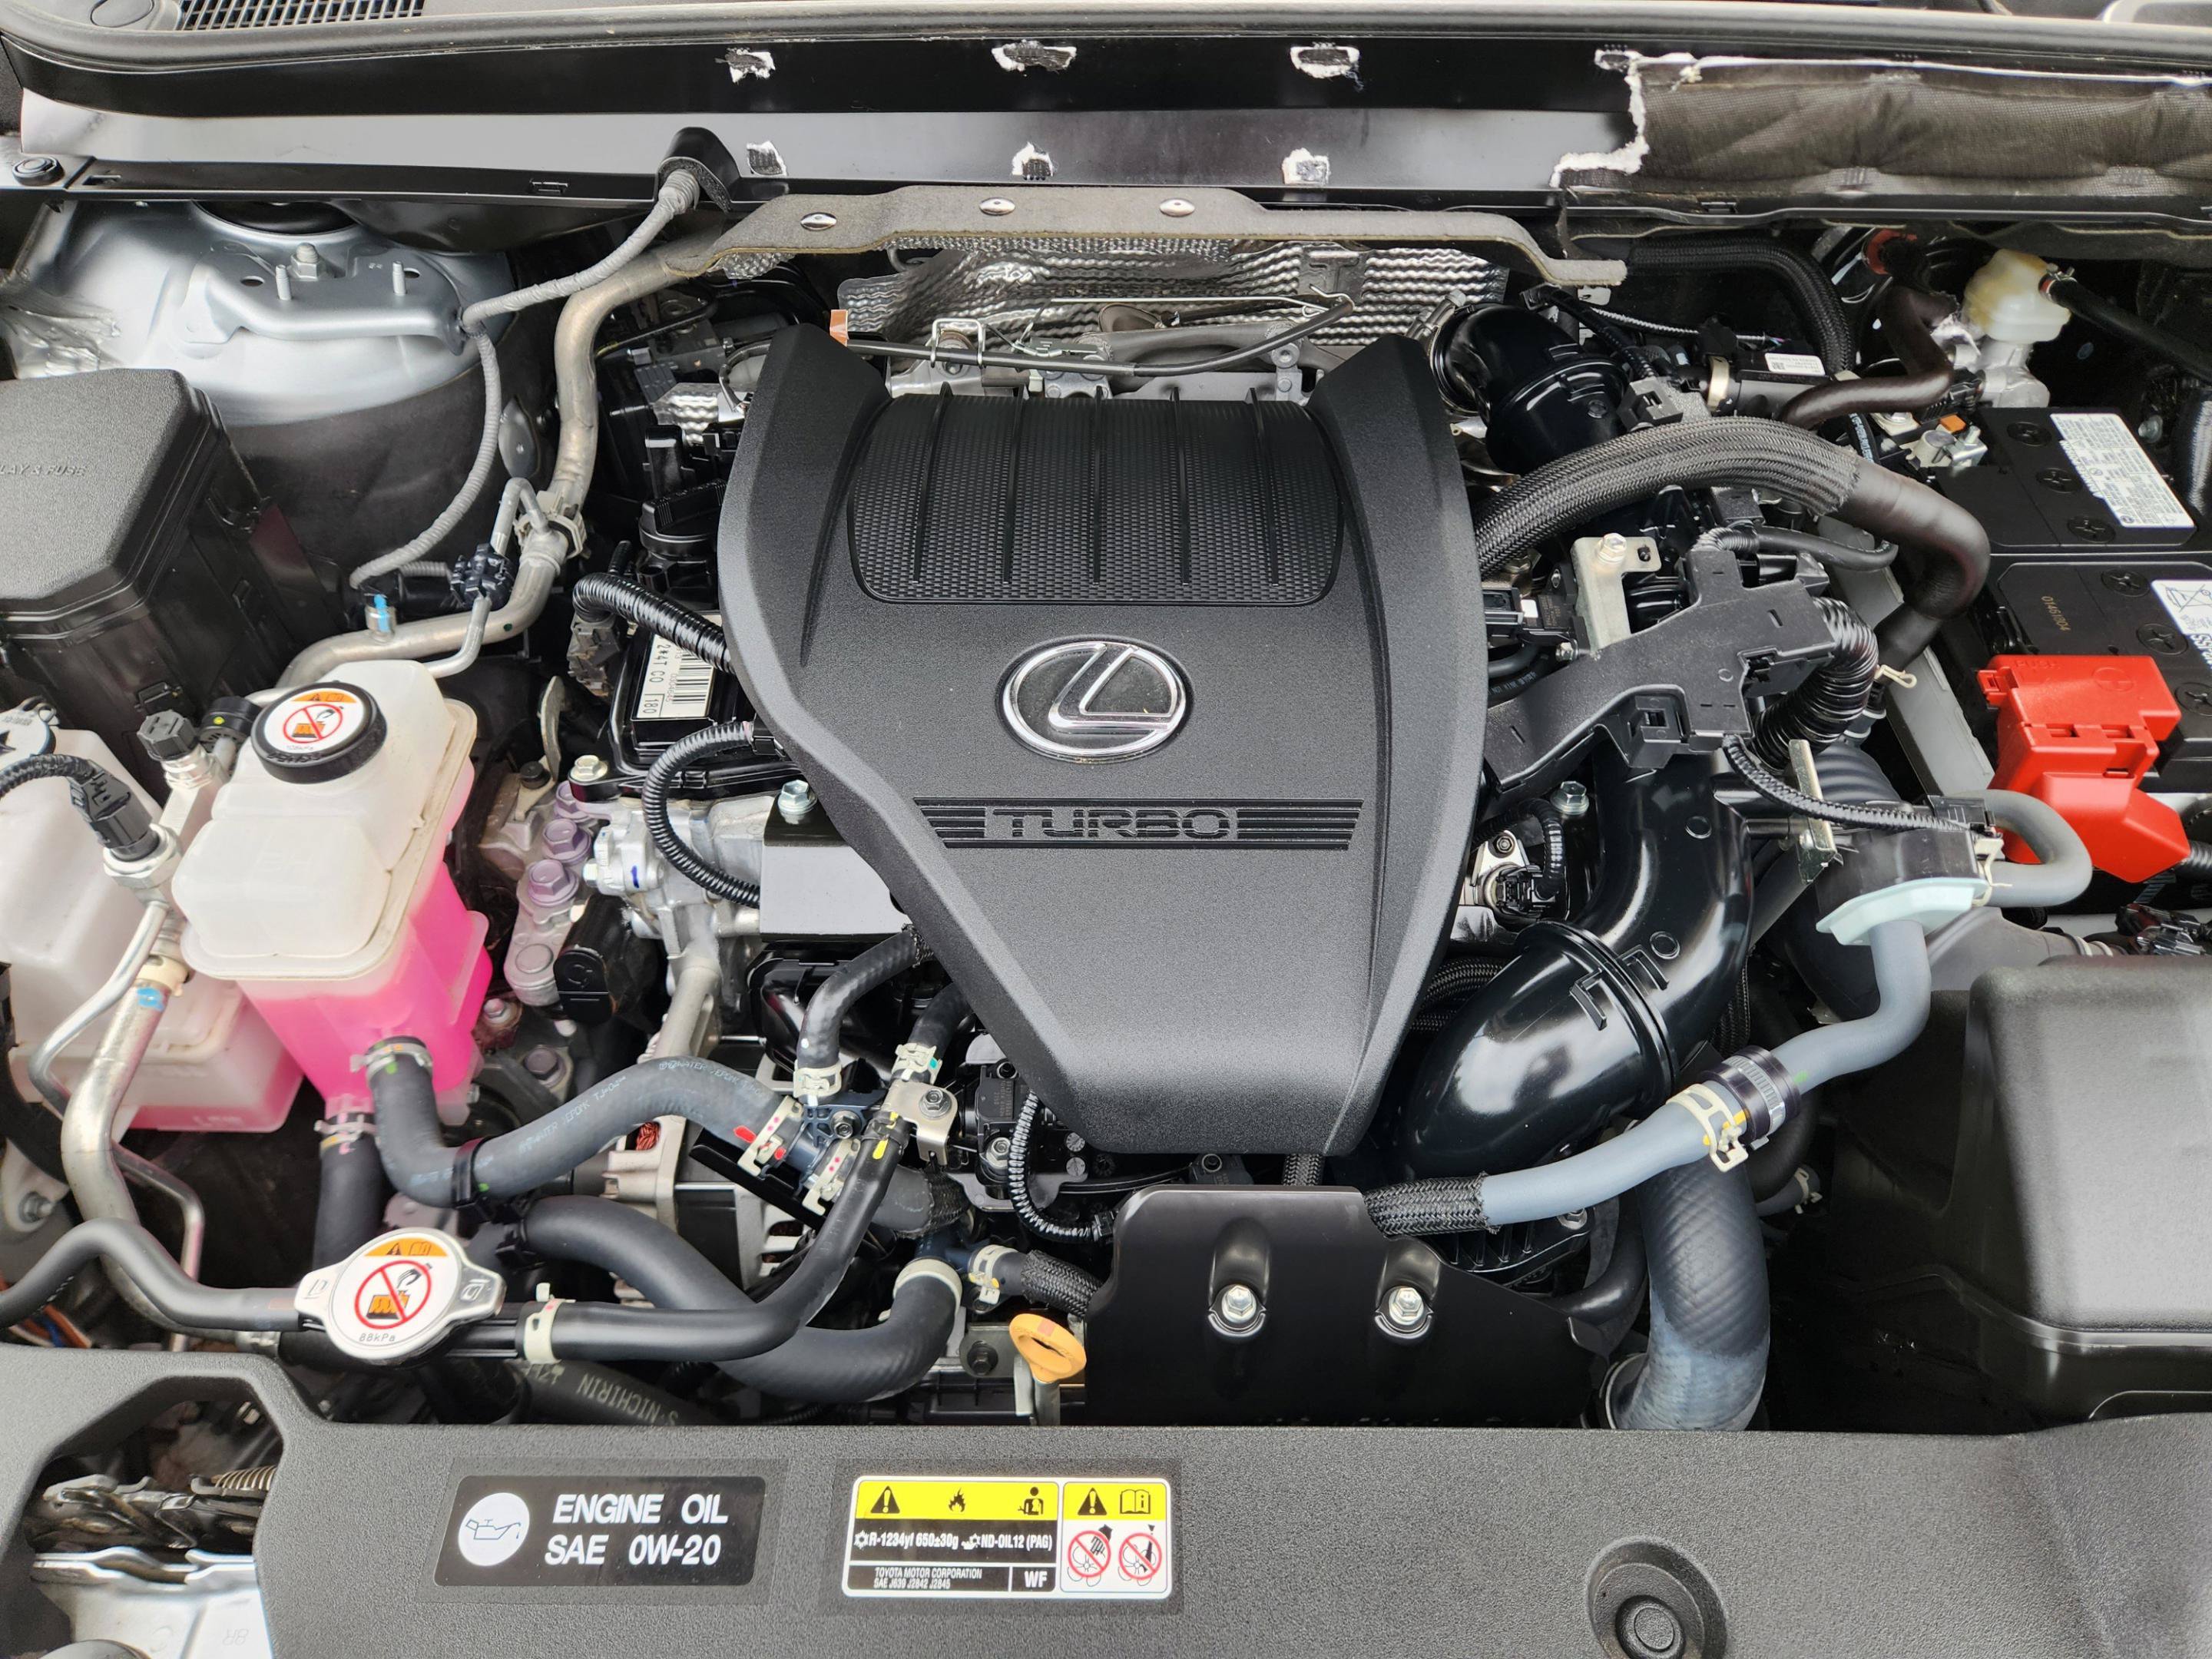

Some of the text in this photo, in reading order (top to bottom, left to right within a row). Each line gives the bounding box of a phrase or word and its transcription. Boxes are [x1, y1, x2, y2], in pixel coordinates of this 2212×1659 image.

[642, 698, 659, 714] 180
[992, 808, 1230, 839] TURBO
[359, 1333, 396, 1342] 88kPa
[552, 1493, 729, 1525] ENGINE OIL
[544, 1534, 721, 1565] SAE 0W-20
[869, 1532, 1053, 1551] R-1234yf 650±30g ND-OIL12 (PAG)
[874, 1567, 982, 1579] TOYOTA MOTOR CORPORATION
[1024, 1570, 1048, 1588] WF
[873, 1578, 951, 1590] SAE J639 J2842 J2845
